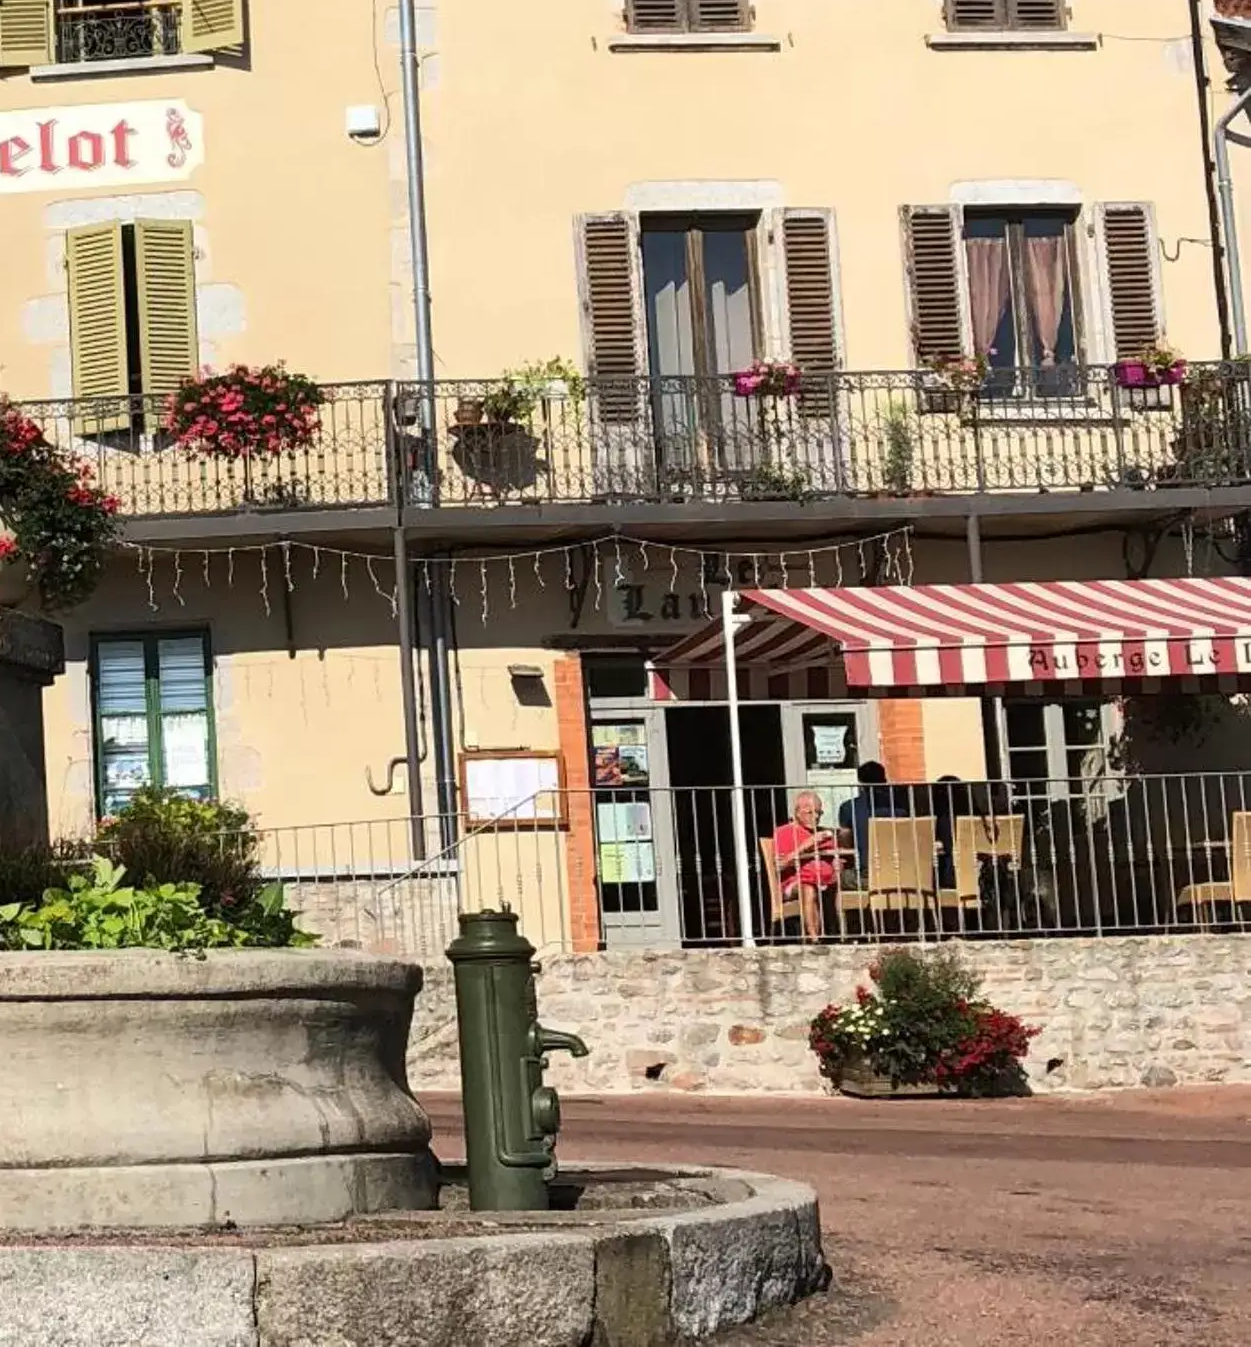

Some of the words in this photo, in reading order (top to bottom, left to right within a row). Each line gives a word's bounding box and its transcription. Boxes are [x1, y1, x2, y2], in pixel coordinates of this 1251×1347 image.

[614, 582, 714, 622] Lan
[1027, 647, 1163, 673] Auberge
[1184, 641, 1222, 666] Le
